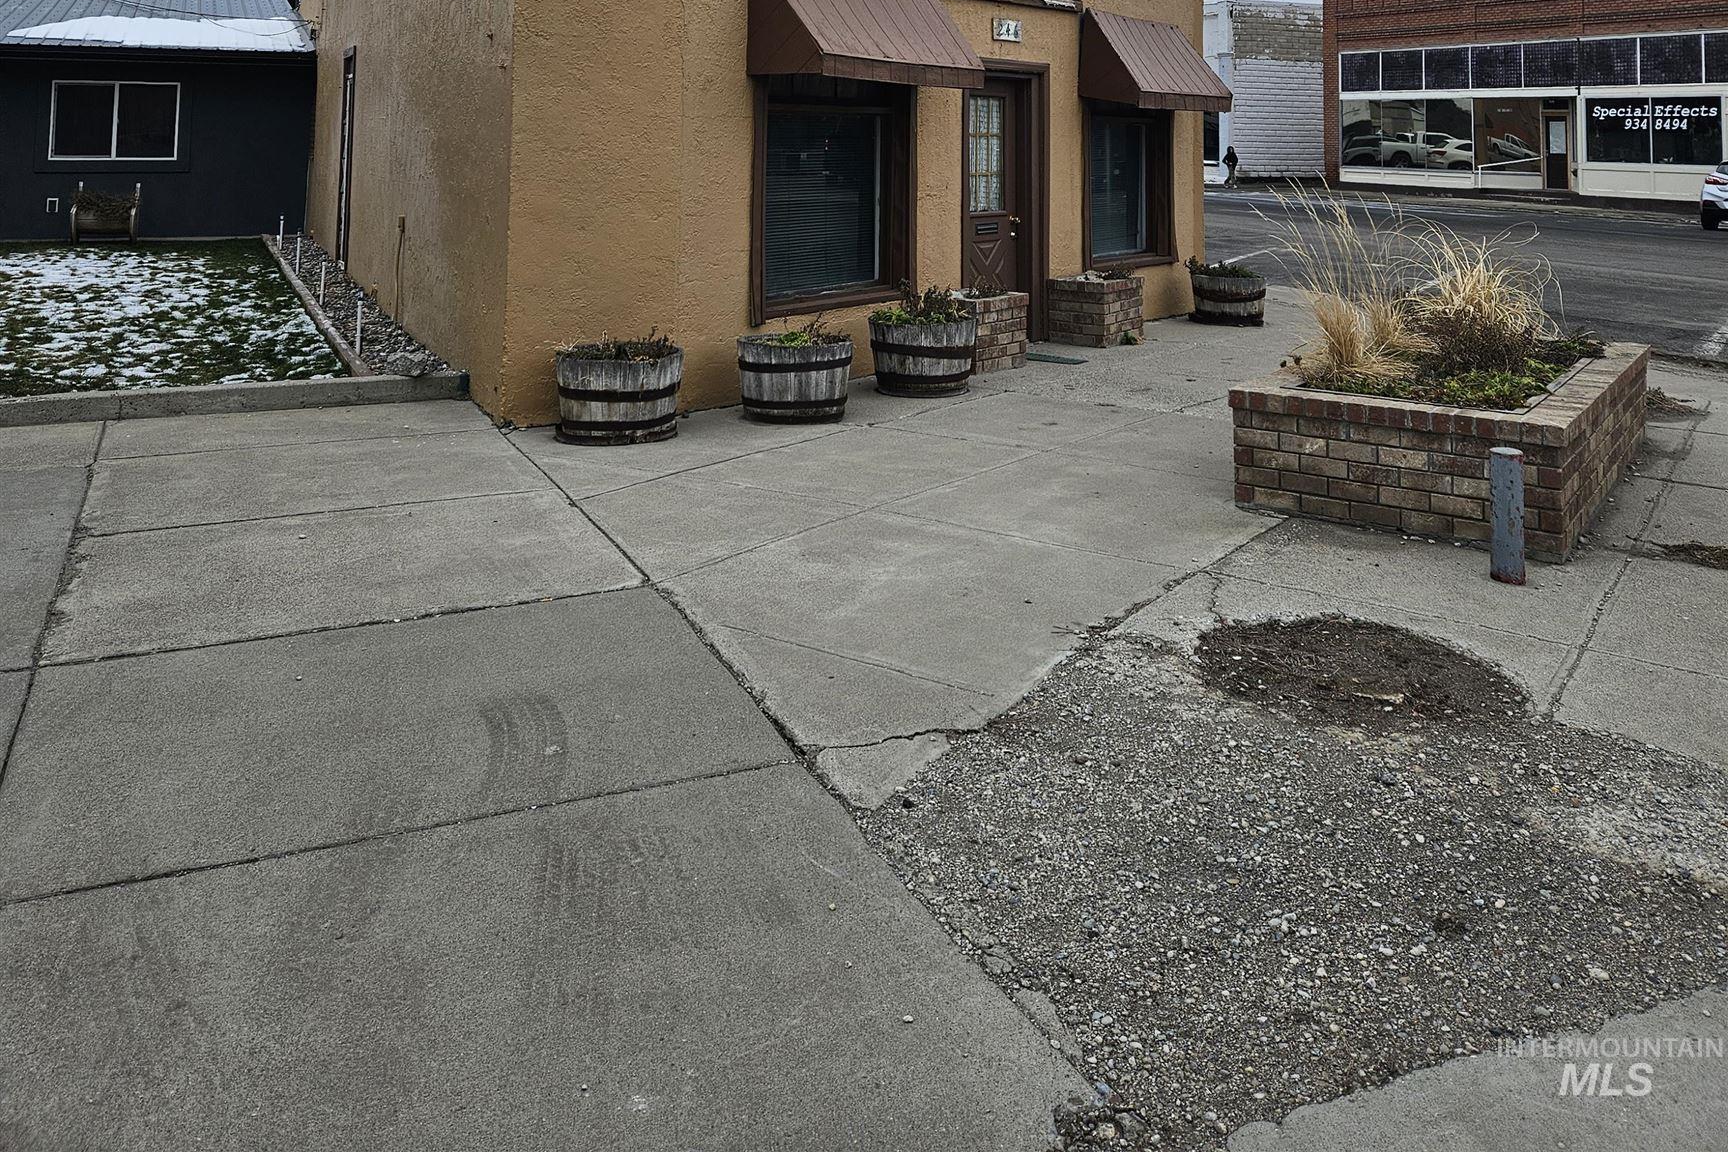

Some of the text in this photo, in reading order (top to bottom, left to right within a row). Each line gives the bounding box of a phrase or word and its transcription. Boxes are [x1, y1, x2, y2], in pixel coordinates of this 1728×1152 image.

[996, 22, 1019, 39] 246
[1592, 105, 1718, 120] Special Effects
[1624, 118, 1688, 130] 934 8494
